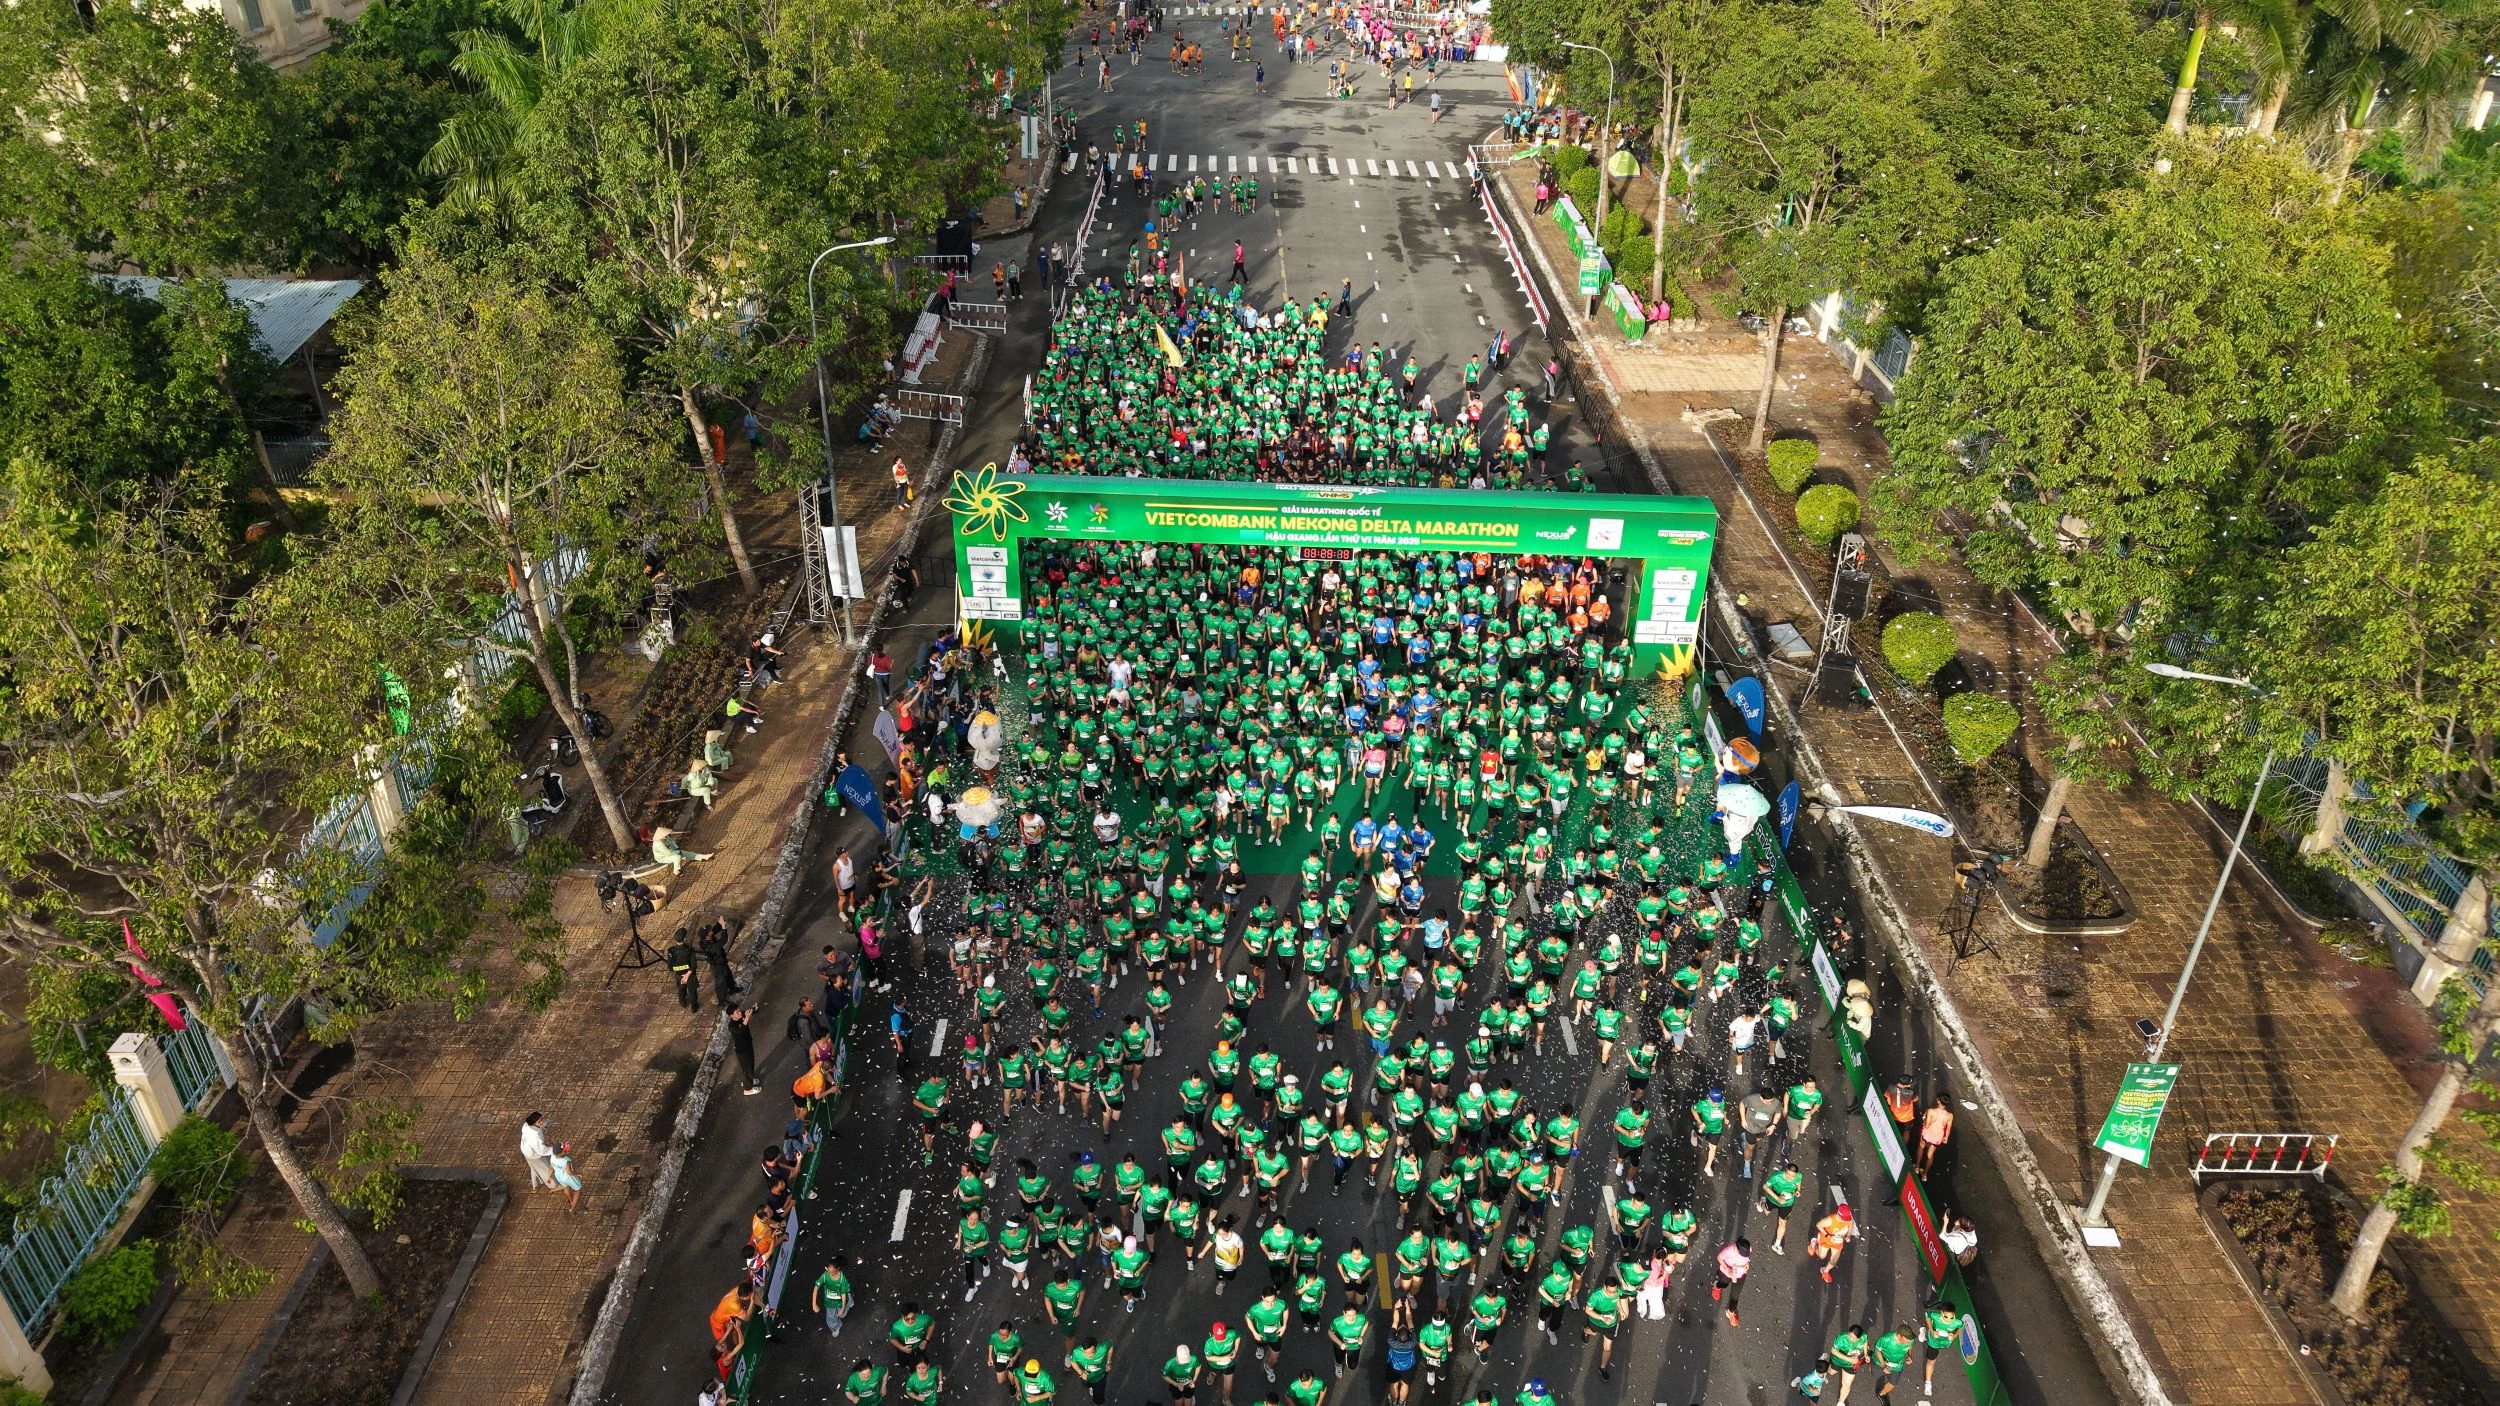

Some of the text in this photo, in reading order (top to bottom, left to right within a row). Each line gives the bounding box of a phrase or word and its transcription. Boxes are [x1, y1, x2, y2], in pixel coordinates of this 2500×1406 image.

[1281, 505, 1382, 516] GIẢI MARATHON QUỐC TẾ
[1145, 512, 1519, 537] VIETCOMBANK MEKONG DELTA MARATHON
[1265, 532, 1286, 542] HẬU
[1287, 533, 1320, 542] GIANG
[1341, 534, 1361, 544] THỨ
[1362, 536, 1372, 544] VI
[1374, 534, 1396, 545] NĂM
[1398, 536, 1420, 545] 2025
[843, 784, 866, 807] NEXUS
[1902, 813, 1946, 833] VNMS
[1907, 1190, 1939, 1267] UDAQUA GEL
